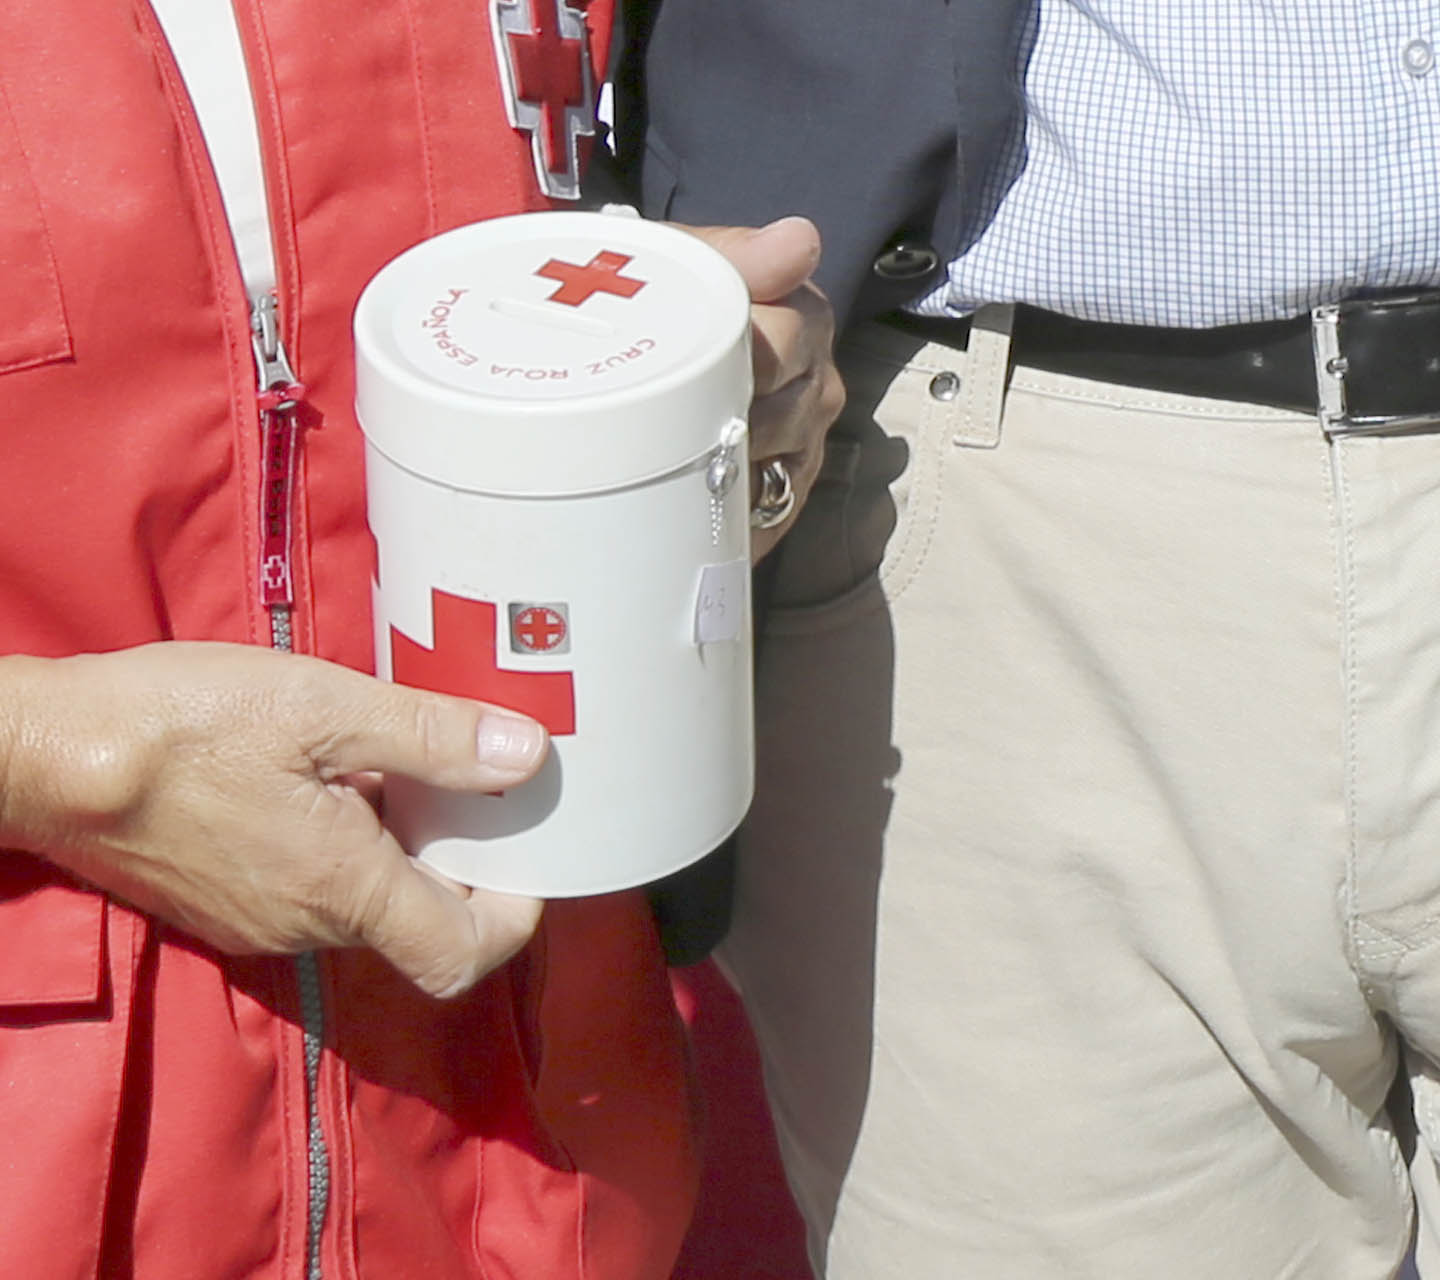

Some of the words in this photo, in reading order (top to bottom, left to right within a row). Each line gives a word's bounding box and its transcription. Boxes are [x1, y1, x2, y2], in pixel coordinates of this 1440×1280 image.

[422, 288, 479, 366] ESPAÑOLA
[491, 364, 569, 381] ROJA
[584, 338, 656, 376] CRUZ
